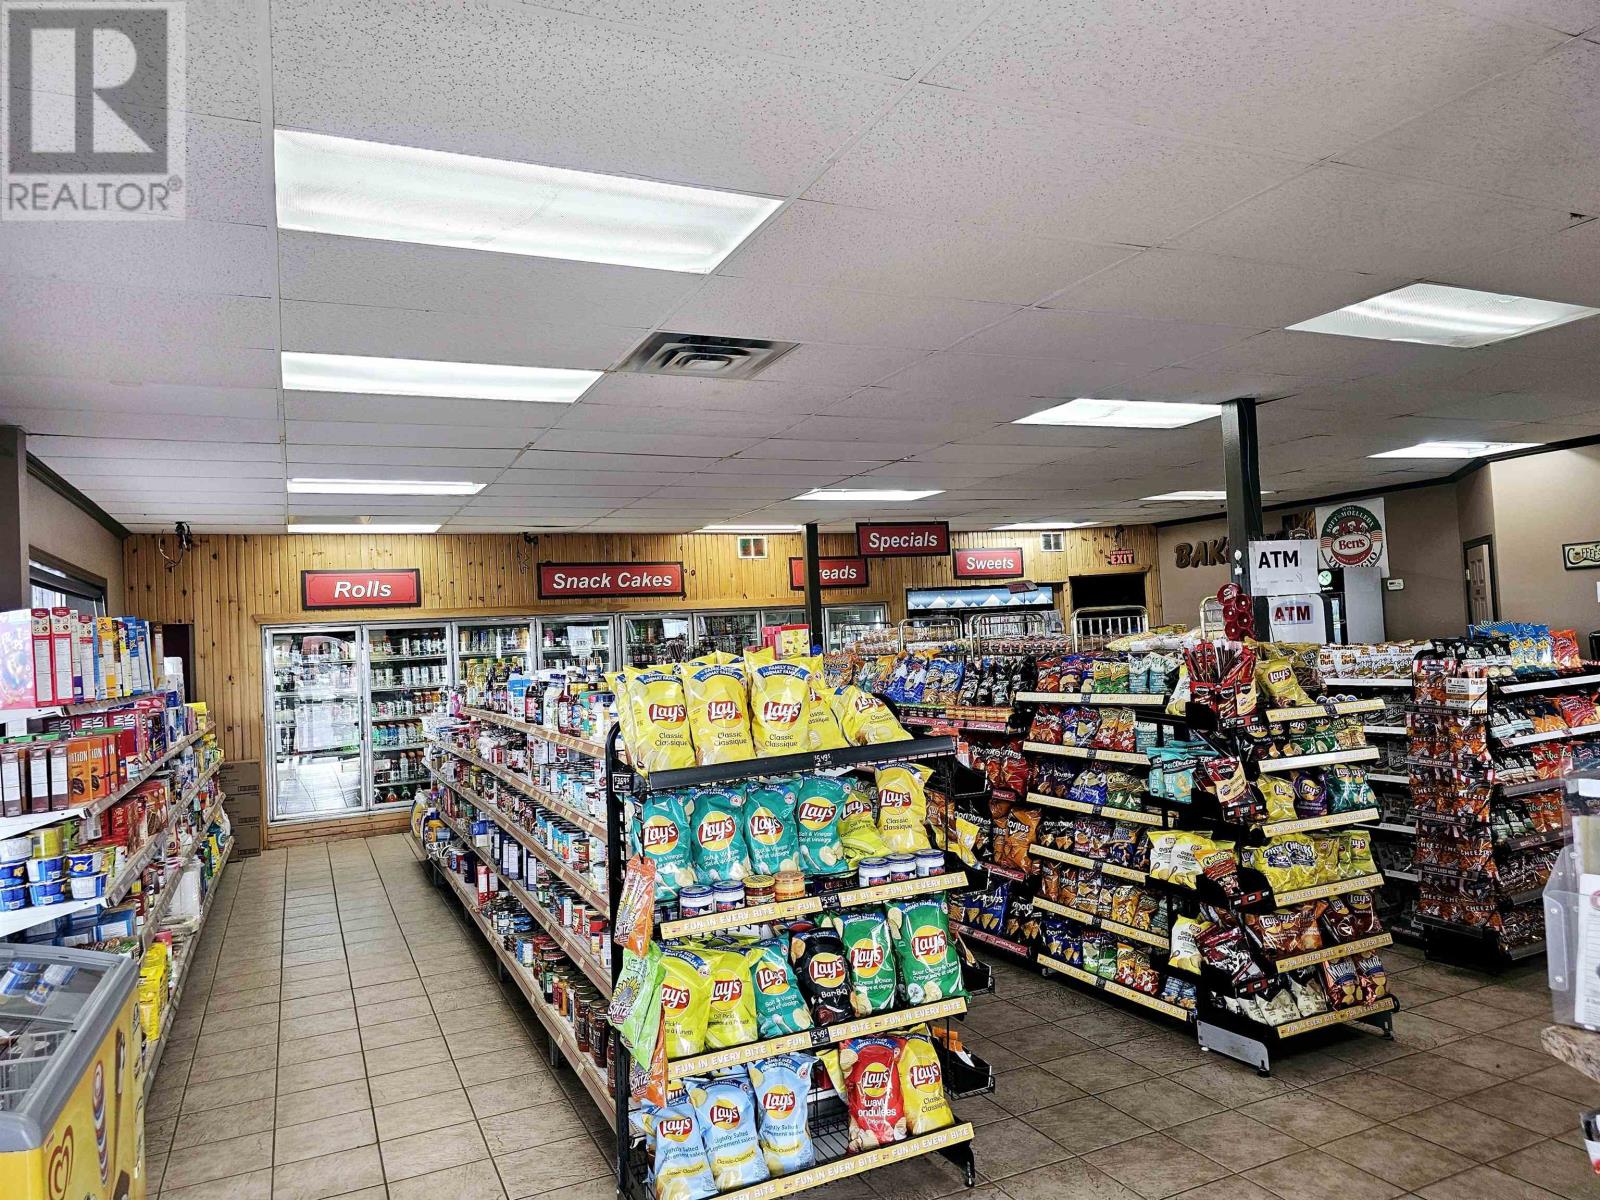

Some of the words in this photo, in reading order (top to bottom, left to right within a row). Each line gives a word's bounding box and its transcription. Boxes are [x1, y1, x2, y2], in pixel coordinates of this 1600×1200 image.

[868, 530, 939, 551] Specials
[1338, 538, 1366, 550] Ben's
[1111, 554, 1133, 564] EXIT
[1174, 537, 1230, 569] BAK
[1258, 550, 1299, 569] ATM
[966, 556, 1015, 571] Sweets
[334, 580, 392, 599] Rolls
[553, 573, 611, 590] Snack
[617, 571, 673, 588] Cakes
[1274, 605, 1311, 622] ATM
[1268, 668, 1290, 683] Lay's
[652, 704, 685, 722] Lay's
[765, 702, 800, 723] Lay's
[765, 740, 798, 748] Classique
[881, 789, 911, 807] Lay's
[800, 803, 834, 823] Lay's
[644, 825, 678, 845] Lay's
[701, 820, 734, 842] Lay's
[752, 815, 780, 836] Lay's
[886, 885, 903, 895] FUN
[905, 884, 913, 893] IN
[917, 878, 941, 890] EVERY
[945, 876, 963, 884] BITE
[684, 922, 704, 931] FUN
[708, 919, 717, 928] IN
[720, 912, 750, 924] EVERY
[752, 908, 775, 918] BITE
[798, 901, 816, 911] FUN
[915, 932, 946, 956] Lay's
[853, 946, 881, 968] Lay's
[814, 958, 844, 980] Lay's
[661, 985, 688, 1008] ay's
[607, 1003, 633, 1020] Spitz
[850, 1023, 871, 1032] BITE
[884, 1016, 901, 1025] FUN
[904, 1013, 914, 1021] IN
[915, 1007, 940, 1018] EVERY
[943, 1003, 961, 1011] BITE
[675, 1063, 694, 1073] FUN
[698, 1060, 708, 1069] IN
[712, 1052, 741, 1063] EVERY
[745, 1046, 766, 1057] BITE
[786, 1037, 805, 1047] FUN
[863, 1070, 889, 1088] Lay's
[912, 1063, 939, 1085] Lay's
[766, 1092, 794, 1111] Lay's
[864, 1098, 887, 1110] wavy
[712, 1106, 738, 1123] Lay's
[661, 1118, 691, 1135] Lay's
[733, 1130, 749, 1139] Salted
[753, 1184, 776, 1196] BITE
[795, 1174, 813, 1186] FUN
[816, 1171, 826, 1180] IN
[828, 1161, 855, 1175] EVERY
[858, 1154, 879, 1166] BITE
[891, 1147, 909, 1158] FUN
[911, 1143, 920, 1152] IN
[922, 1135, 948, 1148] EVERY
[950, 1127, 970, 1138] BITE
